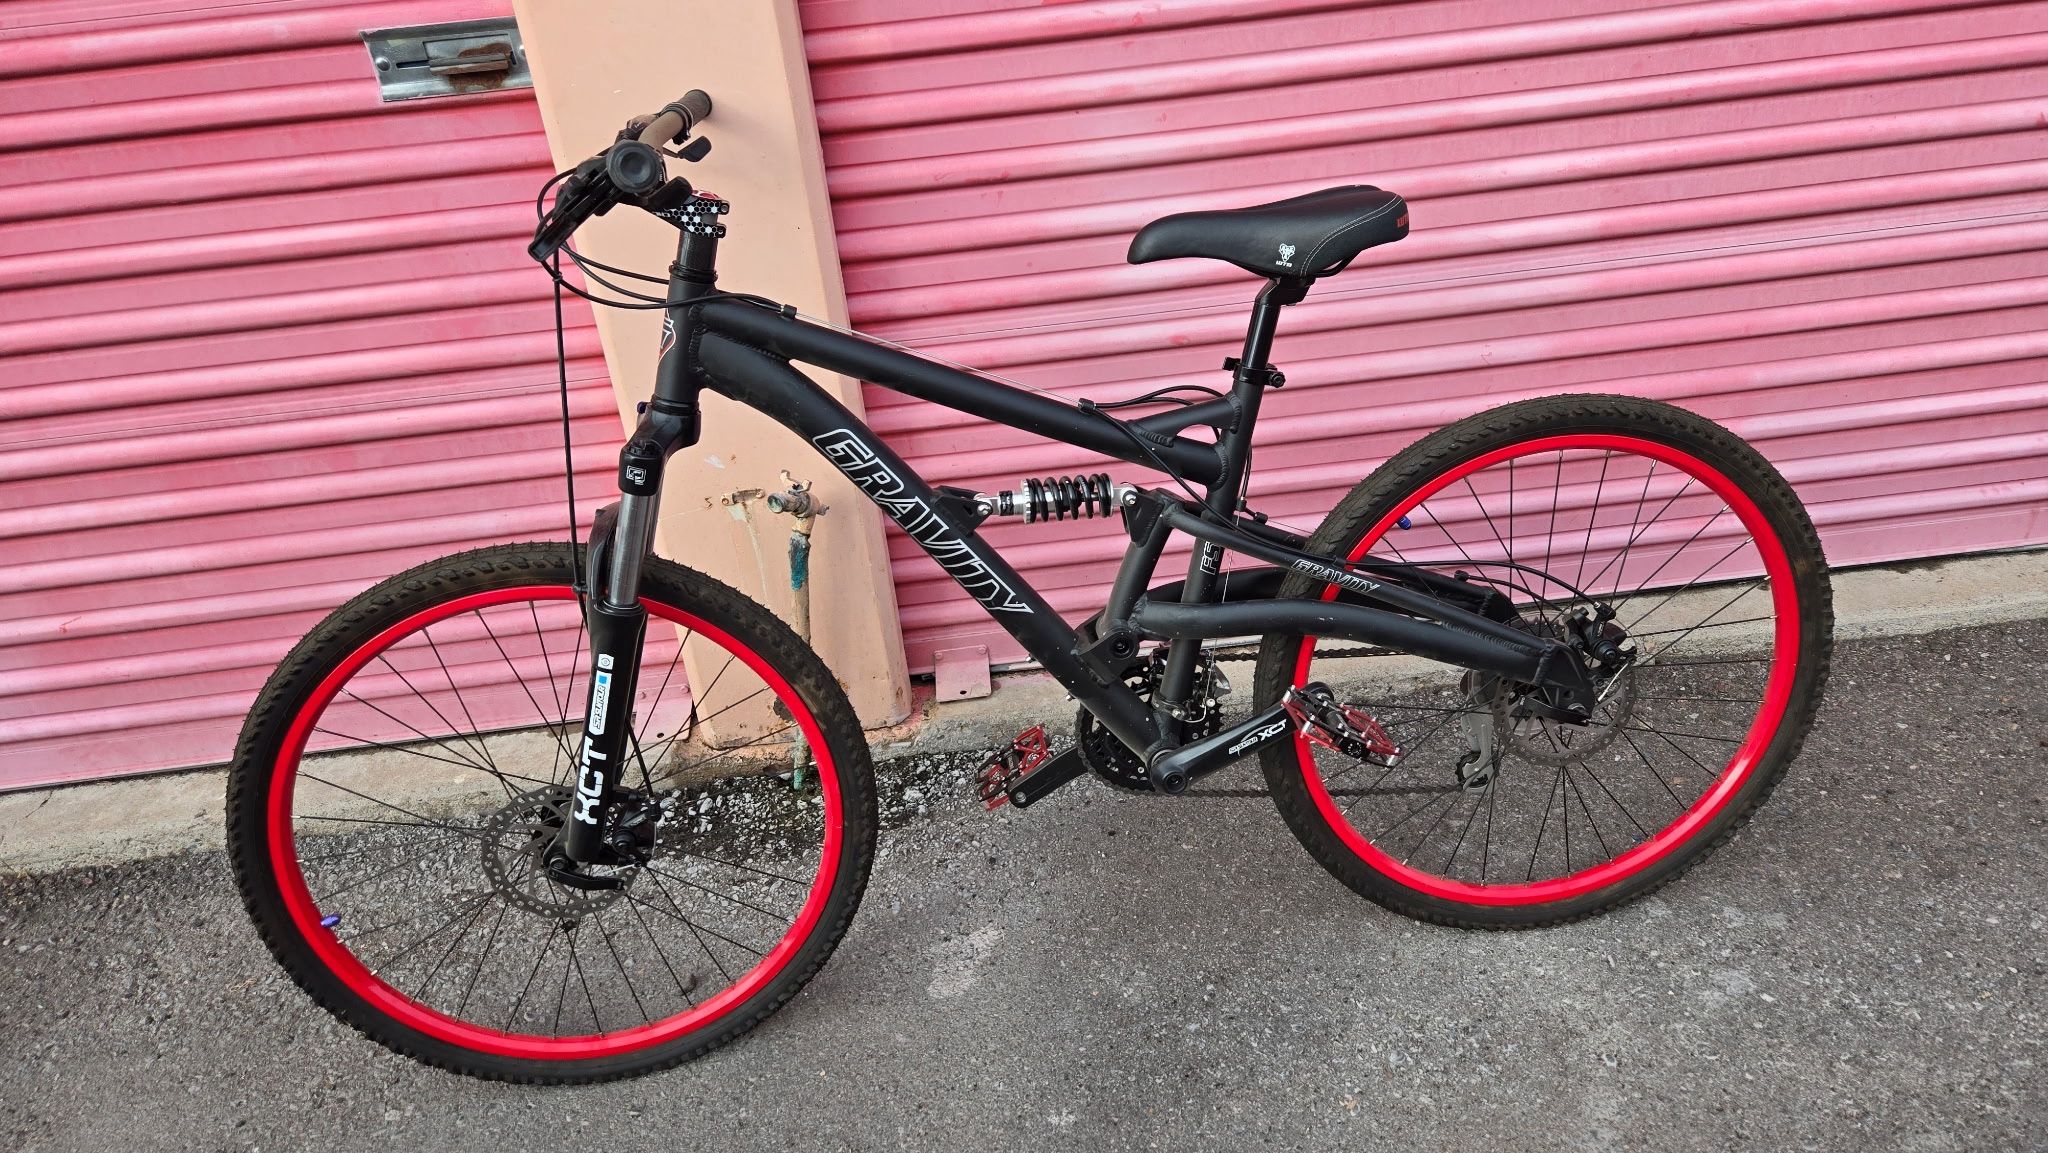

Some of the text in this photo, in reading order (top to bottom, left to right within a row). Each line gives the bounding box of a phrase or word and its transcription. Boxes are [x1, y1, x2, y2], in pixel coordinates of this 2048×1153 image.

[812, 428, 1034, 614] GRAVITY
[1291, 559, 1381, 593] GRAVITY
[1257, 719, 1287, 741] XCT
[574, 735, 607, 825] XCT
